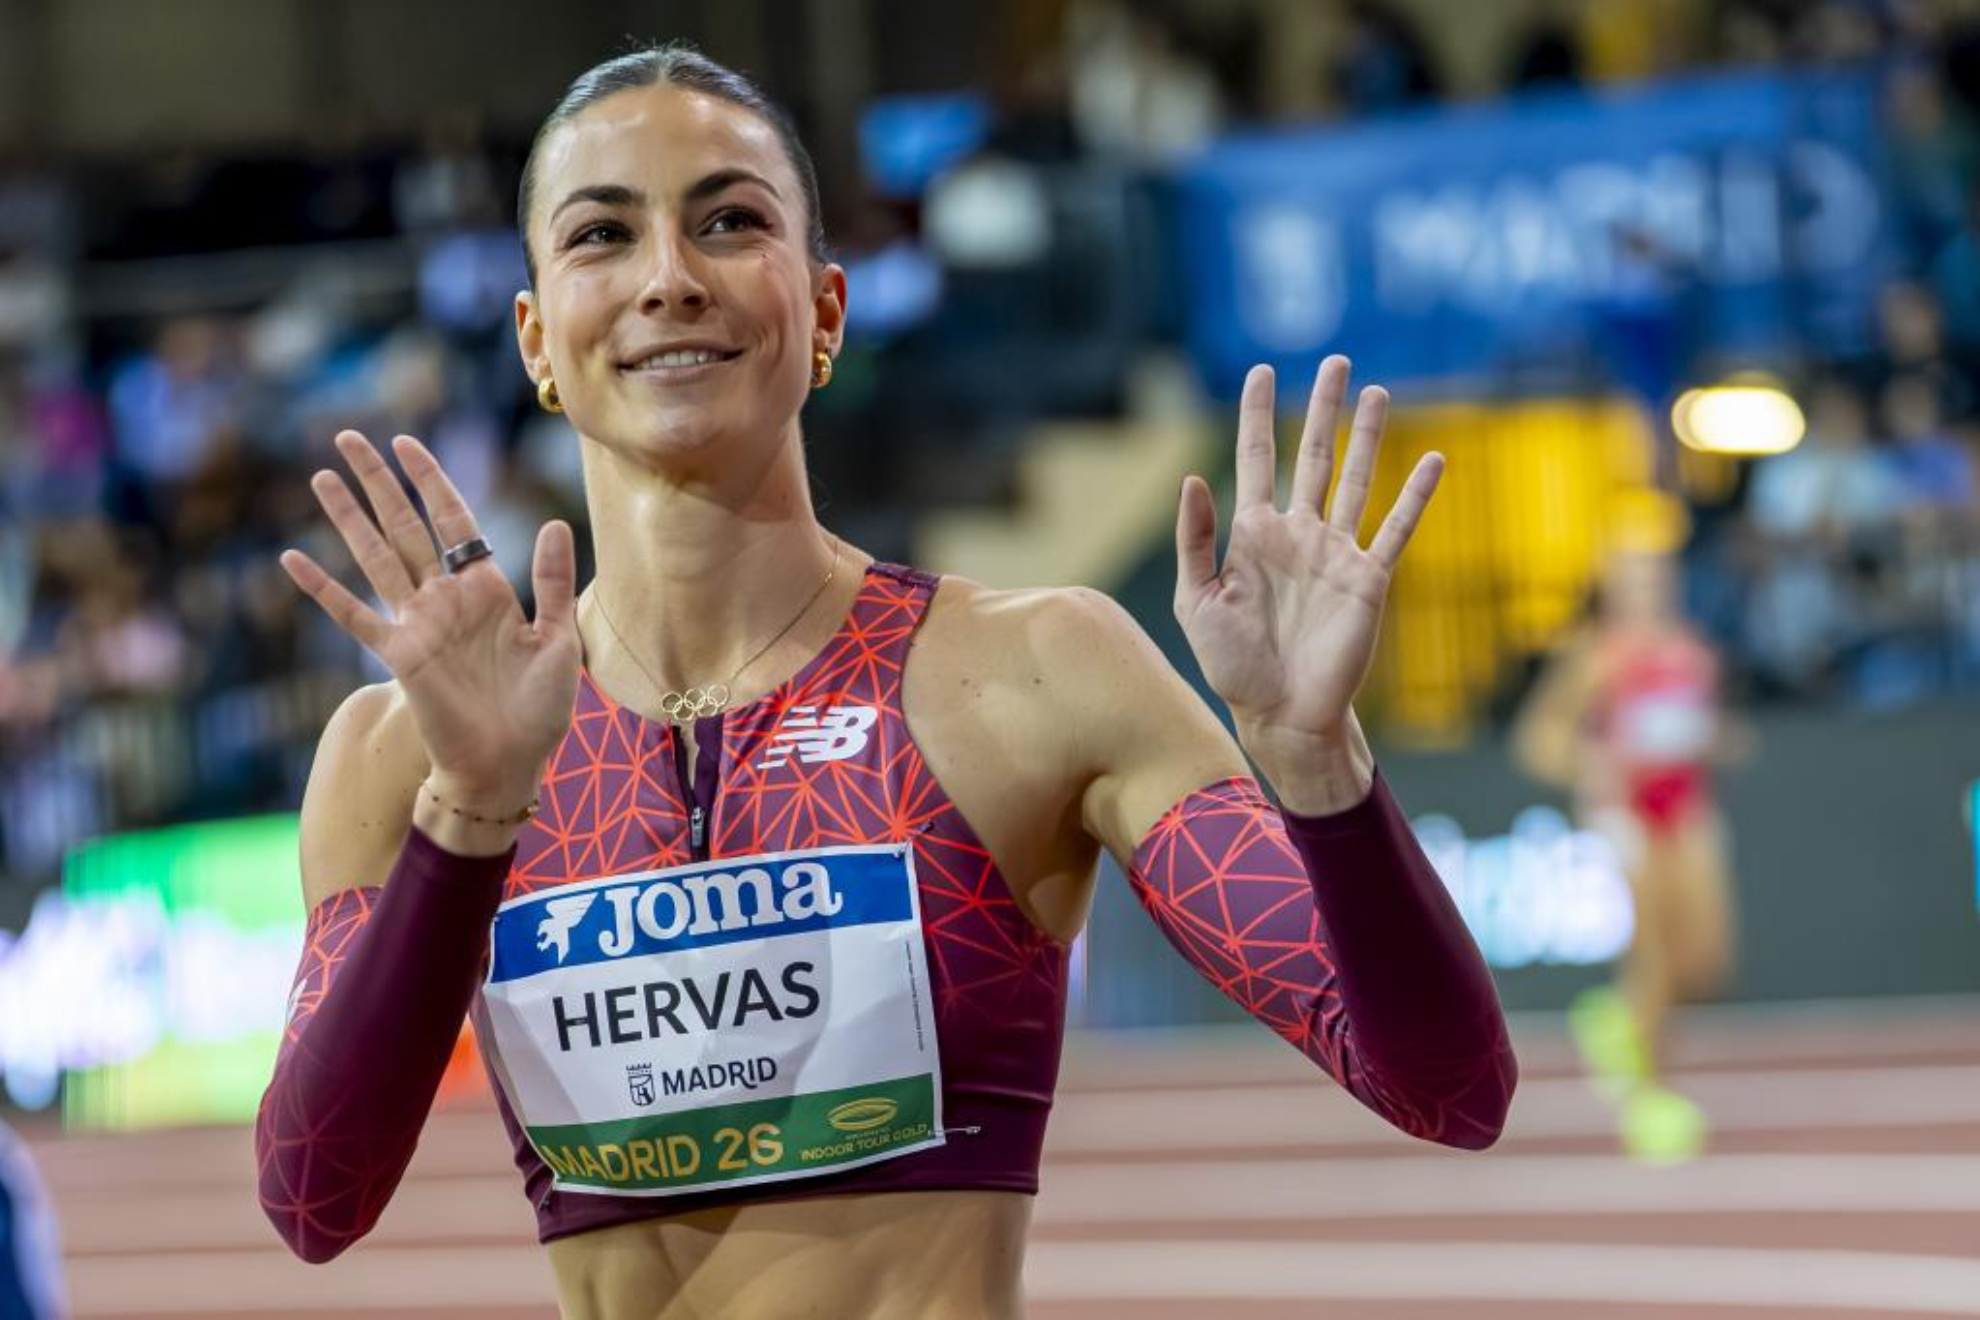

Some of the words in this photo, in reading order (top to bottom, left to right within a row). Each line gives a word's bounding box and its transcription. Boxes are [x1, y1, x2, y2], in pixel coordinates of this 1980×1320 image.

[552, 961, 821, 1052] HERVAS
[662, 1056, 778, 1096] MADRID
[541, 1134, 700, 1182] MADRID
[712, 1123, 784, 1171] 26
[800, 1143, 854, 1161] INDOOR
[855, 1133, 891, 1150] TOUR
